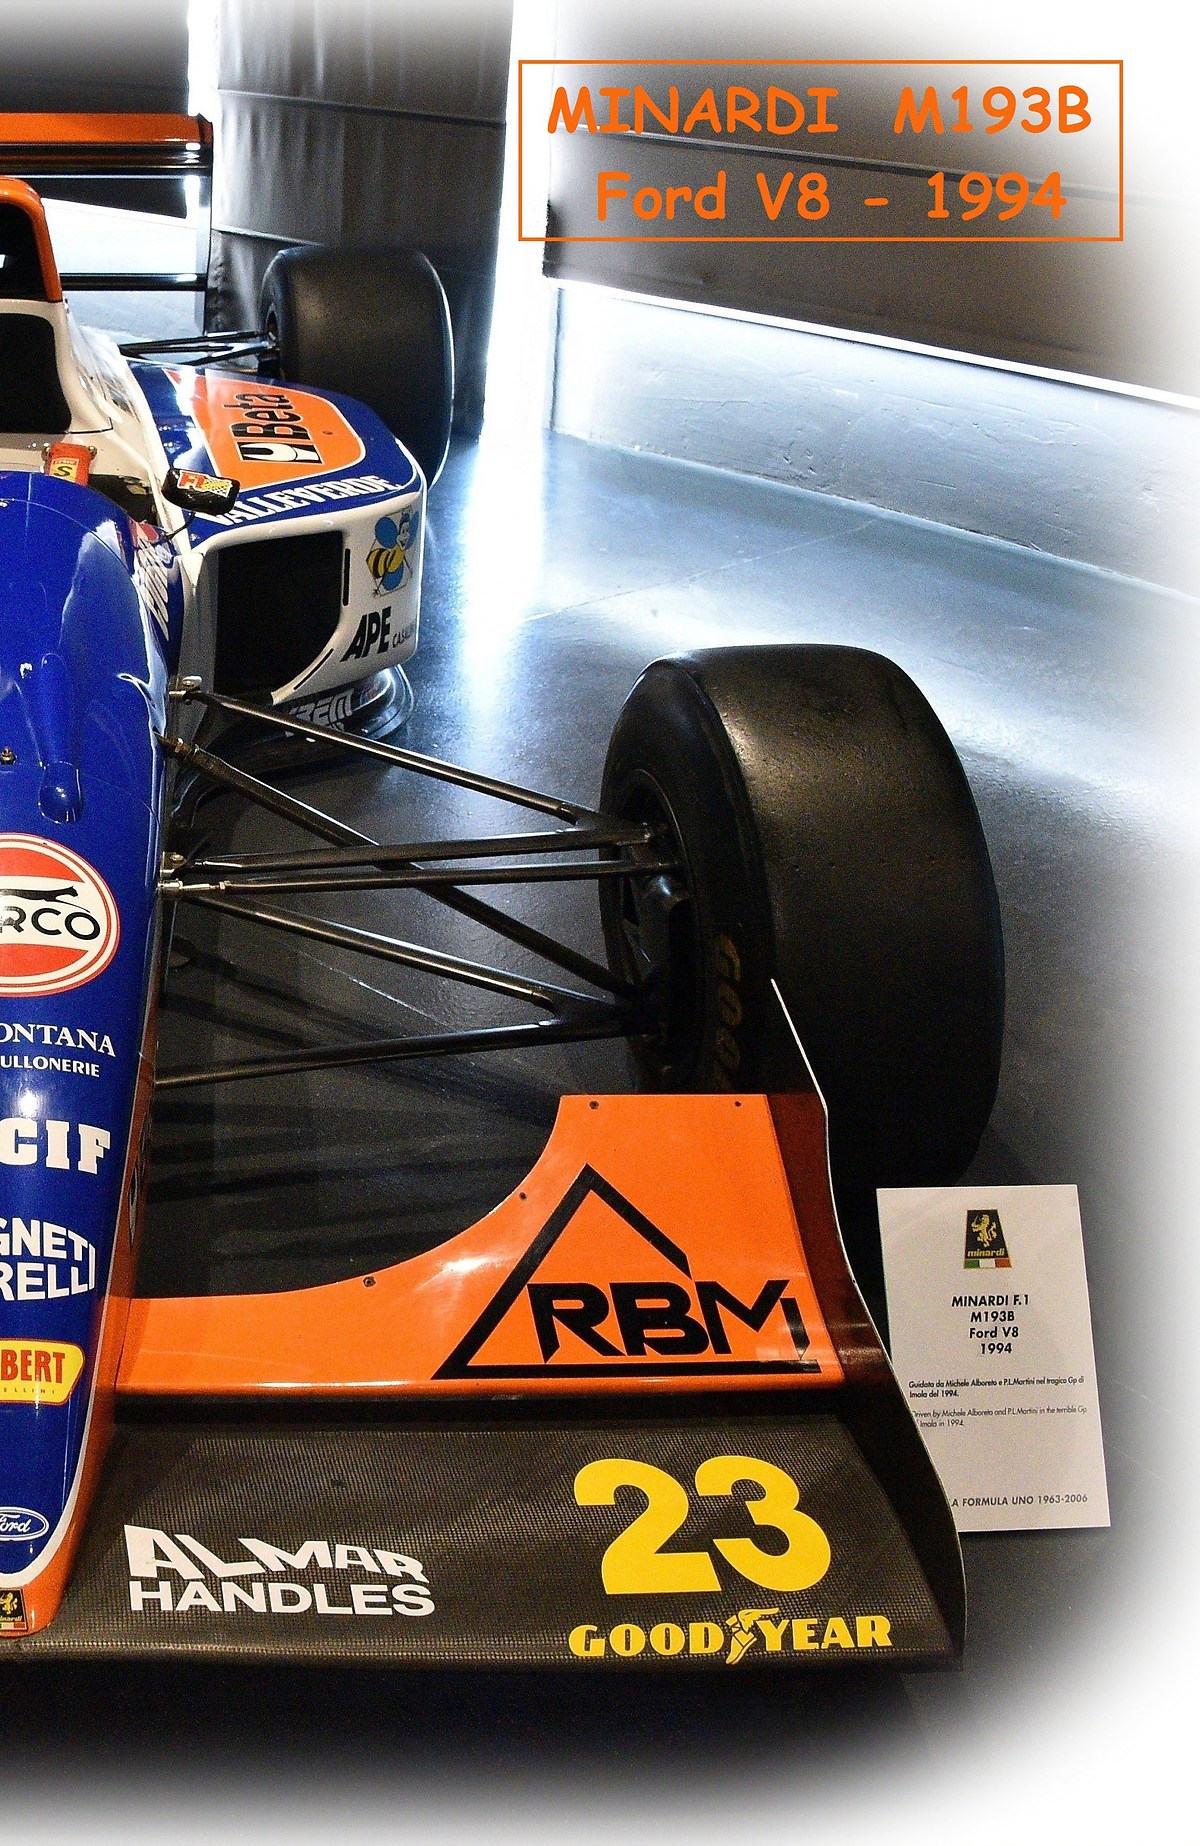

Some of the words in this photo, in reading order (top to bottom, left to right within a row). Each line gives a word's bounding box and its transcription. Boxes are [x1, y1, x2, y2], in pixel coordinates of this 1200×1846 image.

[223, 394, 313, 441] Beta
[339, 605, 392, 662] APE
[967, 1248, 1006, 1258] minardi
[951, 1295, 1009, 1307] MINARDI
[1013, 1294, 1029, 1306] F.1
[527, 1279, 811, 1364] RBM
[970, 1310, 1015, 1323] M193B
[969, 1326, 998, 1339] Ford
[1001, 1326, 1019, 1338] V8
[981, 1342, 1013, 1355] 1994
[908, 1380, 935, 1389] Guidata
[935, 1379, 945, 1389] da
[945, 1379, 970, 1388] Michele
[971, 1378, 998, 1387] Alboreto
[1036, 1376, 1046, 1385] nel
[1046, 1376, 1067, 1386] tragico
[1068, 1376, 1078, 1386] Gp
[1078, 1375, 1085, 1384] di
[909, 1389, 928, 1399] Imola
[929, 1389, 939, 1398] del
[941, 1389, 959, 1398] 1994.
[932, 1409, 941, 1419] by
[942, 1409, 966, 1417] Michele
[967, 1408, 994, 1417] Alboreto
[994, 1406, 1007, 1416] and
[1039, 1406, 1046, 1414] in
[1046, 1405, 1056, 1414] the
[1056, 1405, 1077, 1414] terrible
[1077, 1405, 1087, 1415] Gp
[920, 1419, 938, 1428] Imola
[962, 1496, 1009, 1507] FORMULA
[1011, 1495, 1034, 1505] UNO
[1037, 1493, 1089, 1505] 1963-2006
[573, 1455, 832, 1595] 23
[123, 1524, 430, 1584] ALMAR
[128, 1579, 436, 1617] HANDLES
